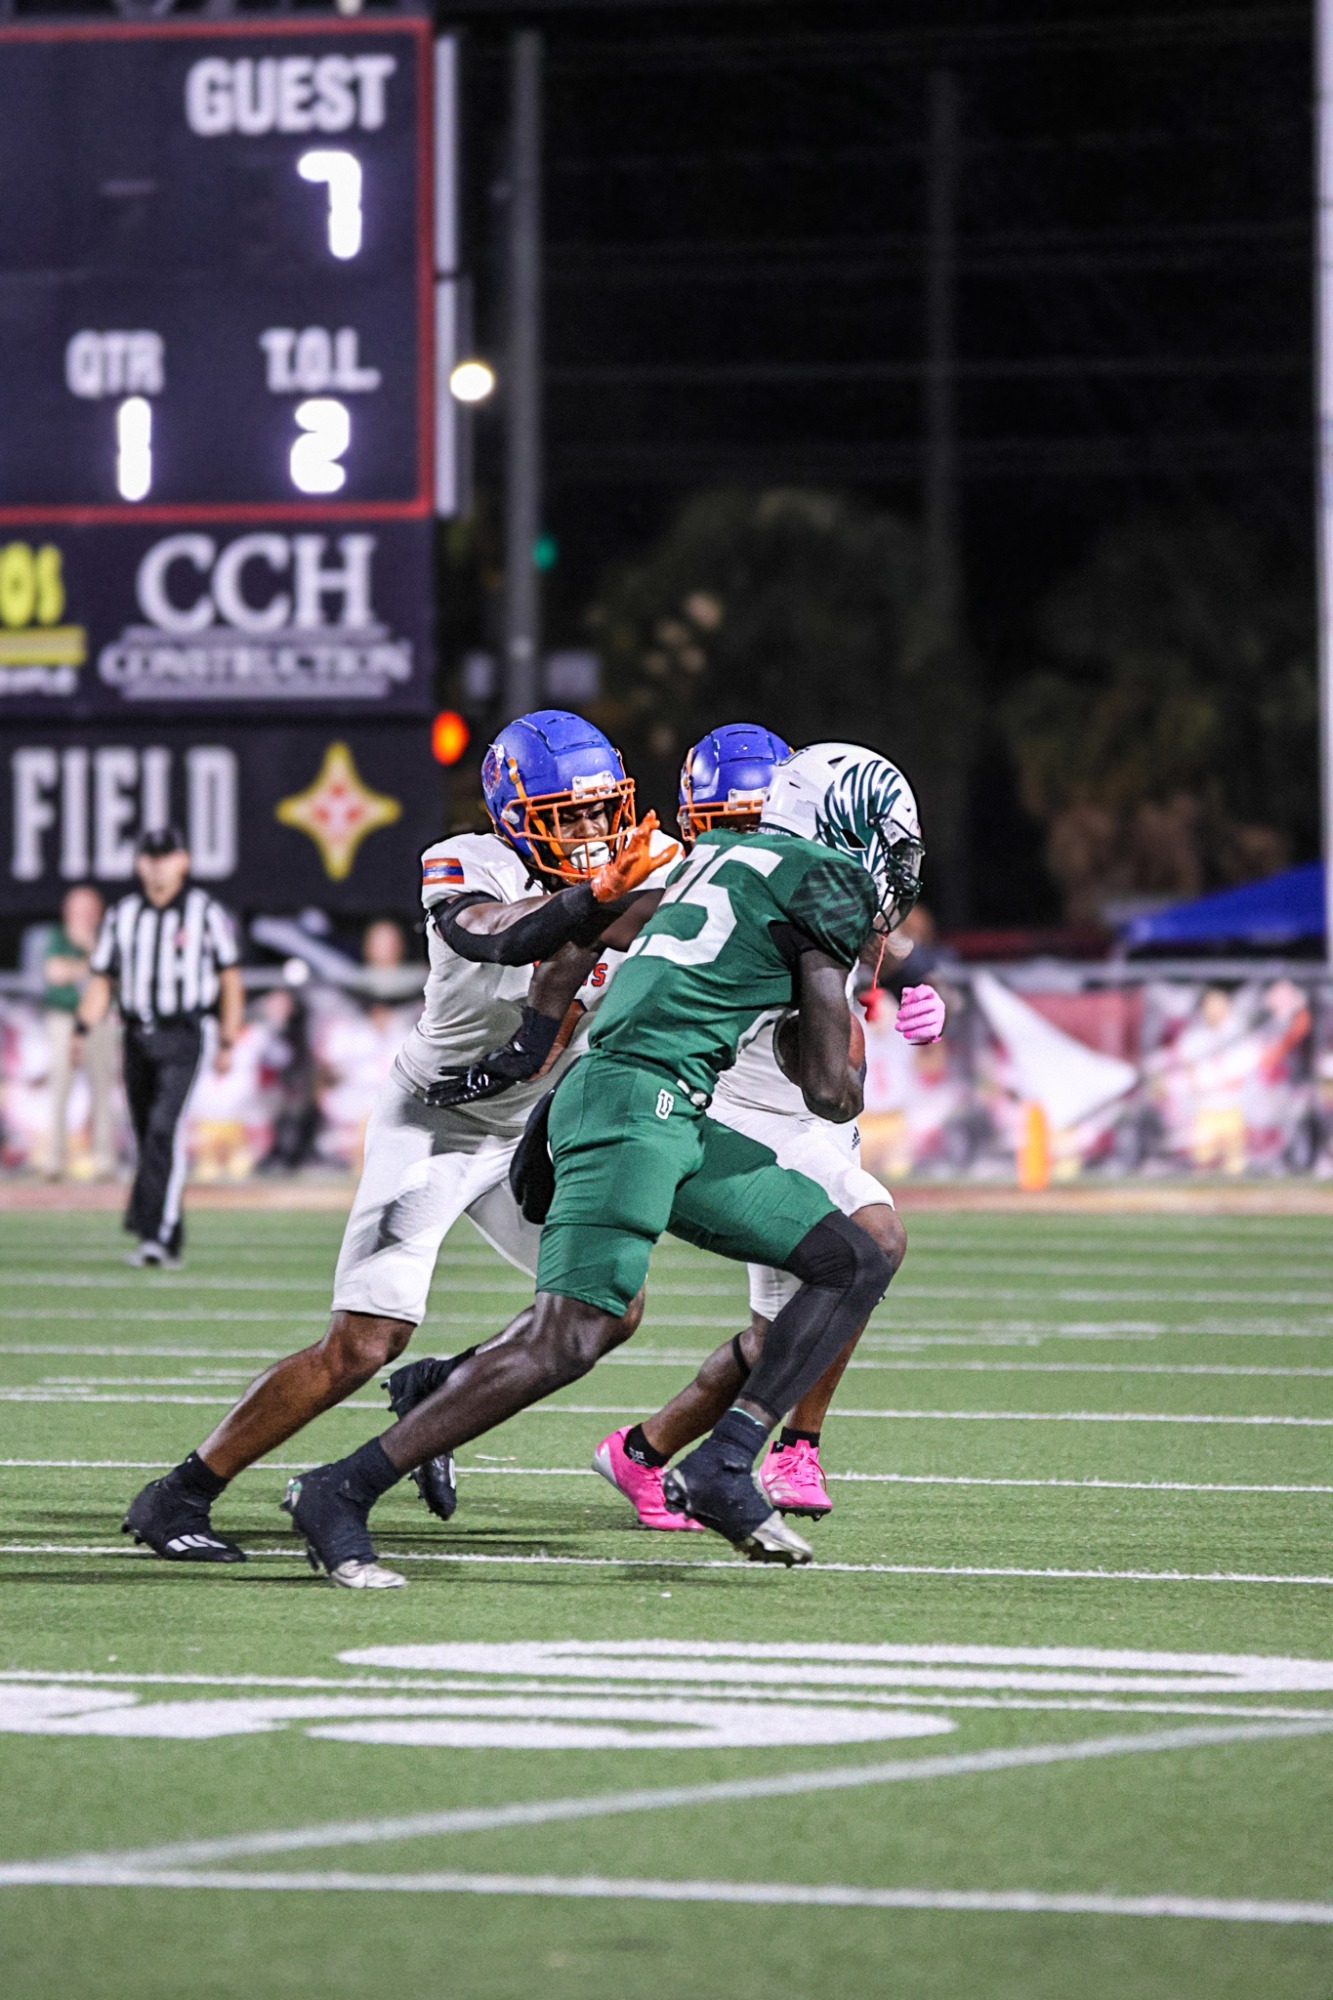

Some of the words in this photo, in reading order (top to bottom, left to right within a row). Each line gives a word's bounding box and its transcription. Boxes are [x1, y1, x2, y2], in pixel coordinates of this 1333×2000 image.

[186, 55, 396, 135] GUEST
[298, 150, 362, 260] 7
[117, 397, 152, 501] 1
[290, 399, 350, 494] 2
[136, 533, 377, 633] CCH
